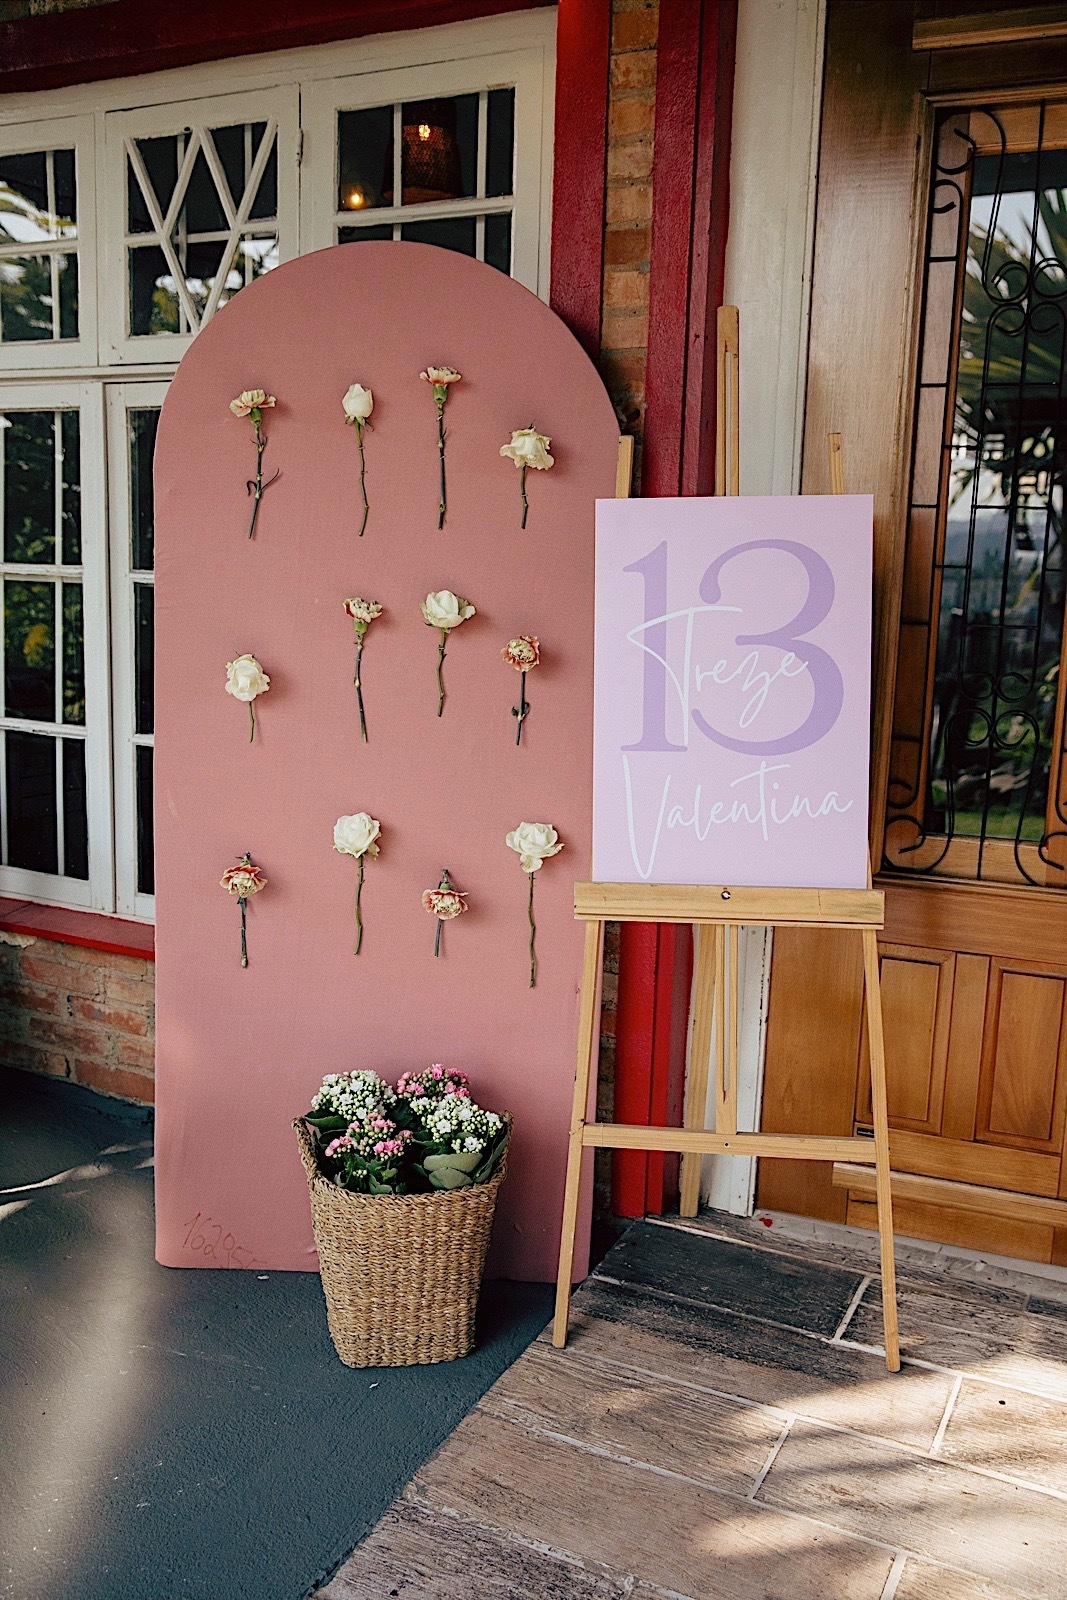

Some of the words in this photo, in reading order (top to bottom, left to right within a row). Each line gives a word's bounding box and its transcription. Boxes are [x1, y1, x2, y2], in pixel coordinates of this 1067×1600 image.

[620, 538, 844, 756] 13
[626, 604, 809, 746] Treze
[622, 753, 853, 880] Valentina
